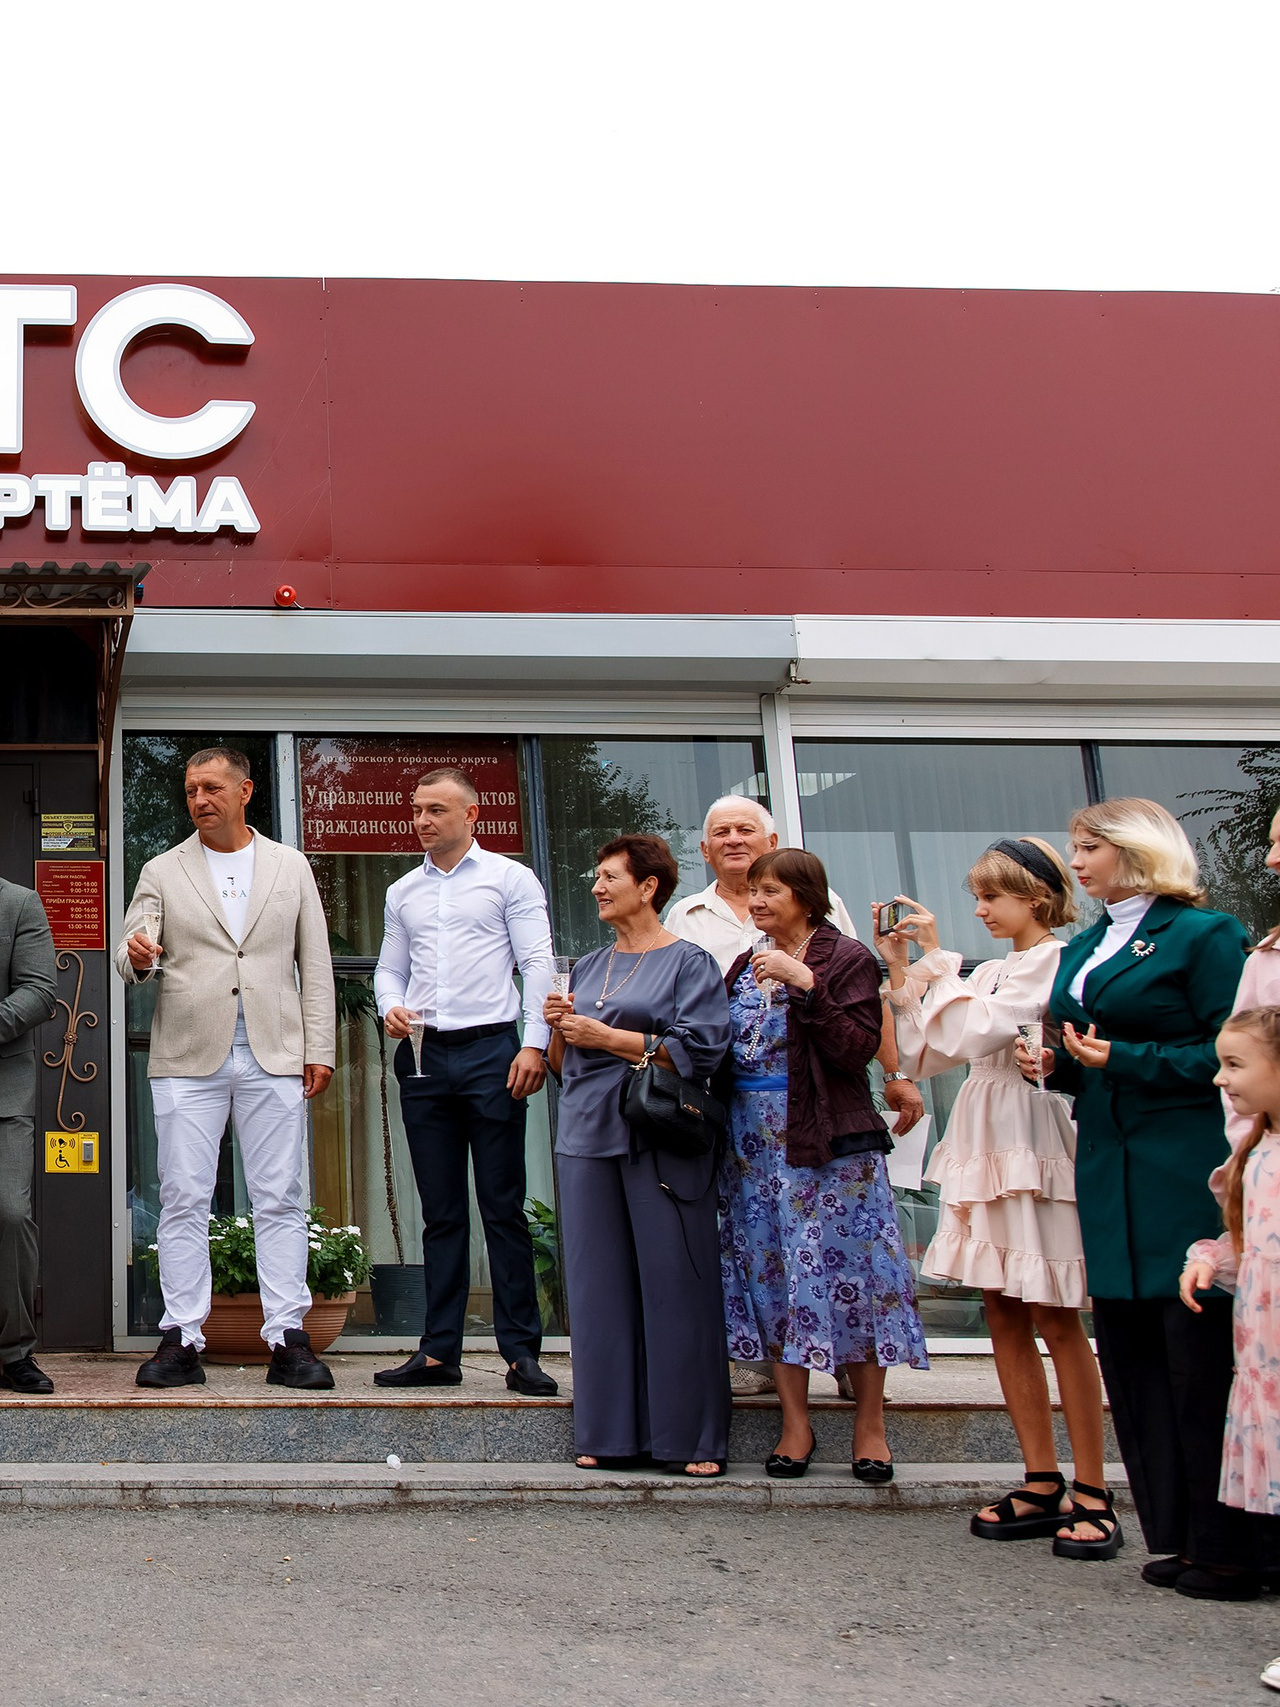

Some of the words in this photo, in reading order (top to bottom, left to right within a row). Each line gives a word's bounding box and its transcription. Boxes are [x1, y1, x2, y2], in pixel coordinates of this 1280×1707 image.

[398, 755, 458, 765] городского
[461, 755, 498, 765] округа
[305, 784, 403, 811] Управление
[306, 819, 414, 839] гражданског
